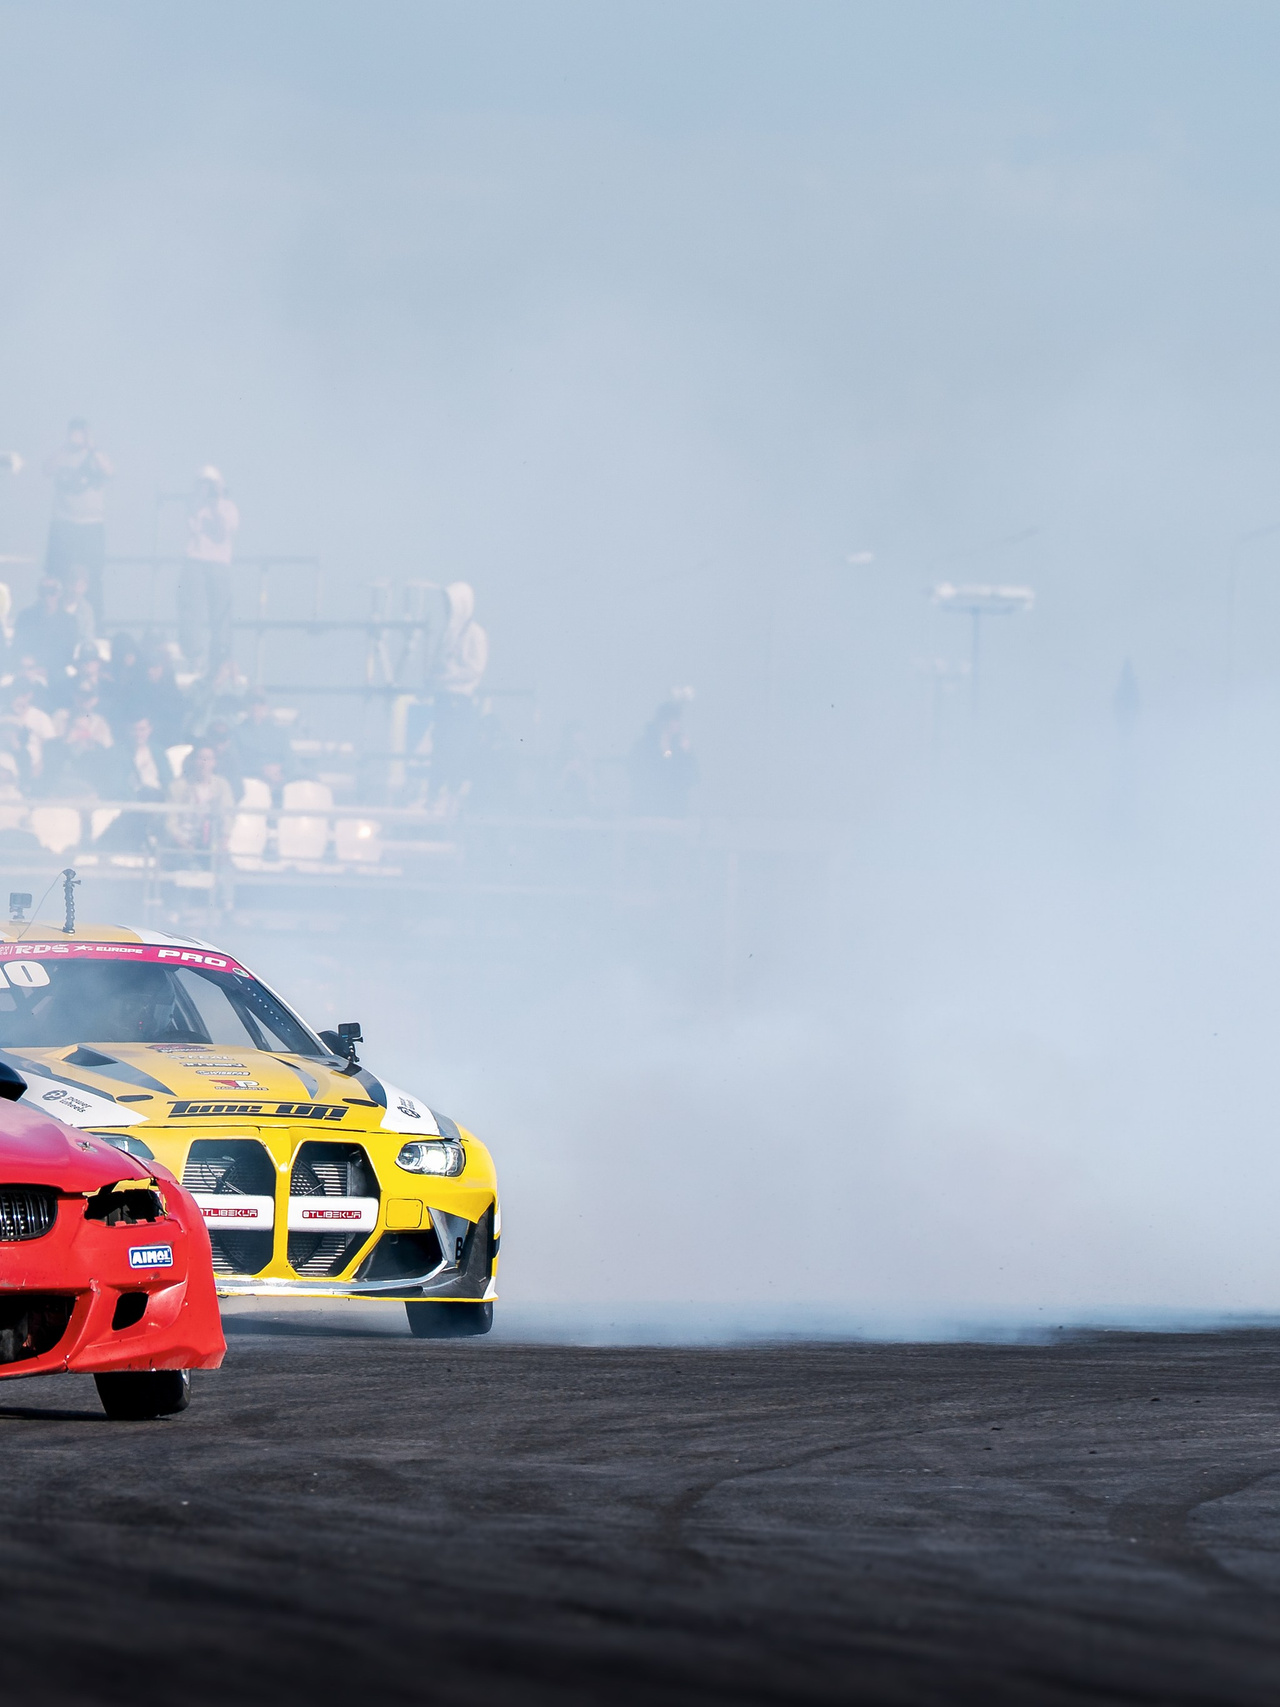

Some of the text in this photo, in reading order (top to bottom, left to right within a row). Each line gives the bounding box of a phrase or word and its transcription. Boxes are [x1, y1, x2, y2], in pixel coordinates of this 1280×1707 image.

[15, 943, 227, 968] RDS EUROPE PRO
[132, 1250, 171, 1265] AIMOL
